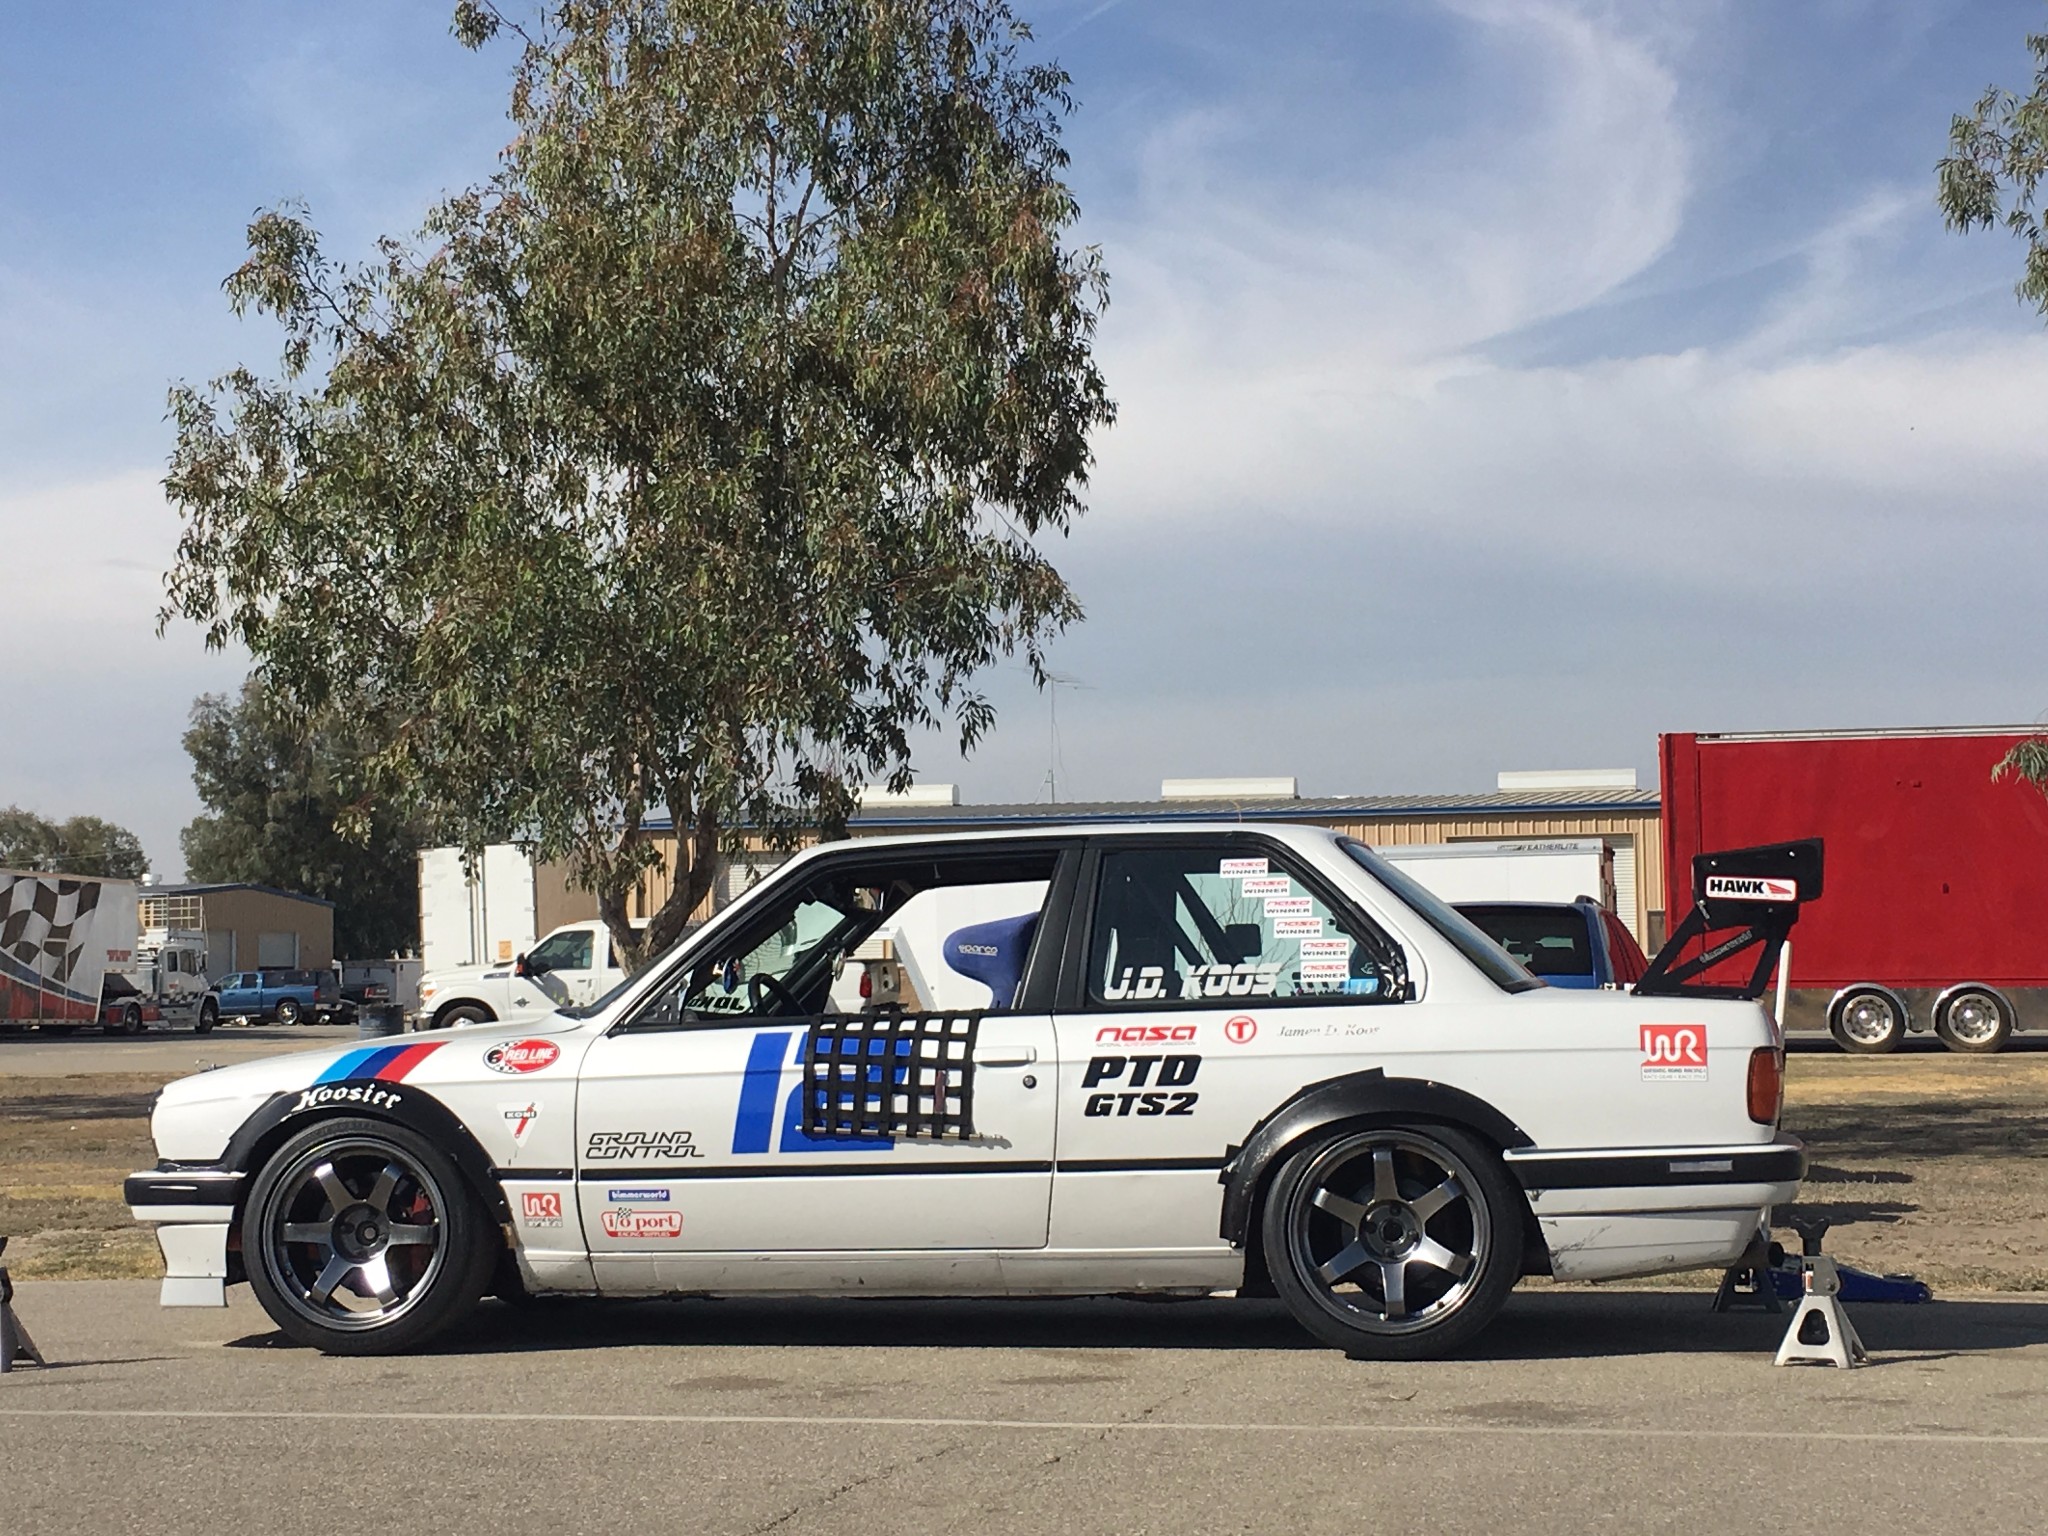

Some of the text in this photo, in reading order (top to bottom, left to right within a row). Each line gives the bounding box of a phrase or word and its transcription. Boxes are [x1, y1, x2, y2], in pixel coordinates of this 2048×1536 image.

[1709, 879, 1765, 894] HAWK
[958, 944, 998, 956] sparco
[1104, 962, 1282, 999] J.D. KOOS
[1302, 971, 1347, 979] WINNER
[1095, 1025, 1197, 1042] nasa
[505, 1047, 556, 1061] RED LINE
[1081, 1054, 1202, 1089] PTD
[290, 1082, 402, 1113] Hoosier
[1084, 1092, 1200, 1117] GTS2
[506, 1111, 535, 1119] KONI
[588, 1131, 693, 1146] GROUND
[585, 1145, 705, 1160] CONTROL
[611, 1189, 668, 1200] bimmerworld
[635, 1213, 674, 1231] port
